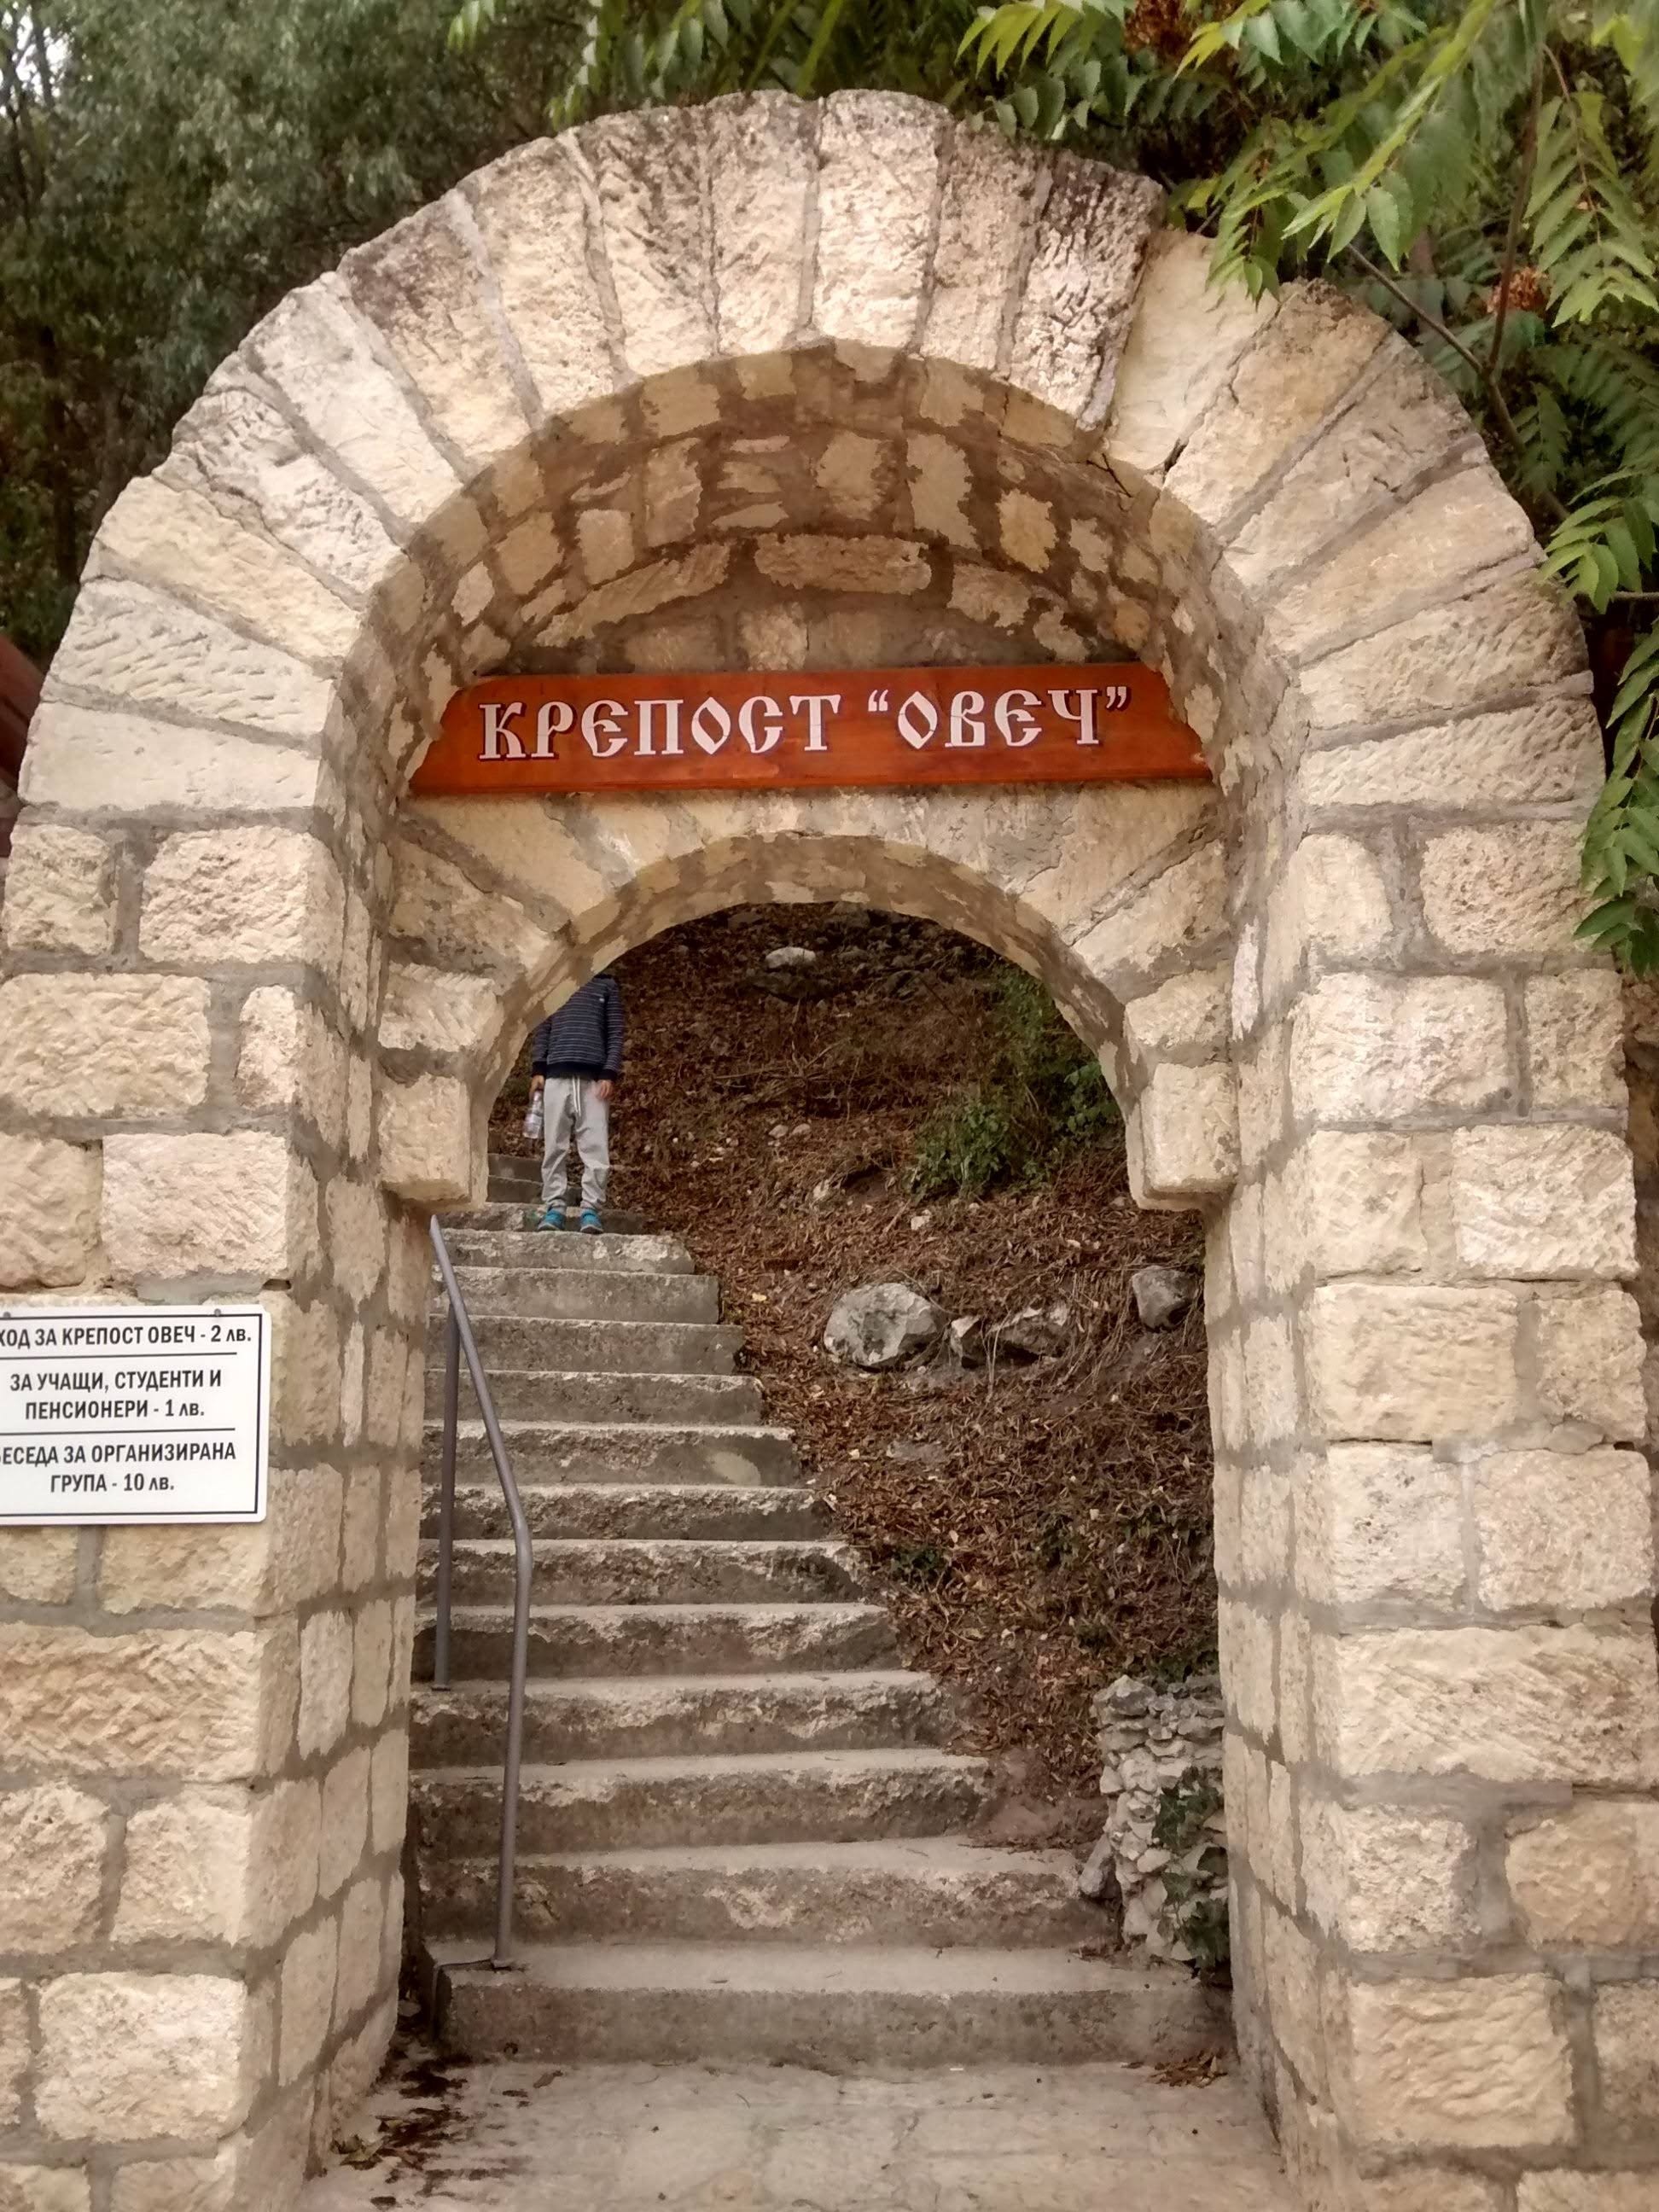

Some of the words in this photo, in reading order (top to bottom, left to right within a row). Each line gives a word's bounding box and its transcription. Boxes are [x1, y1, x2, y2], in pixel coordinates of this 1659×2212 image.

[478, 695, 841, 760] КРЕПОСТ
[35, 1328, 57, 1346] ЗА
[62, 1326, 143, 1346] КРЕПОСТ
[148, 1325, 195, 1344] ОВЕЧ
[211, 1324, 221, 1342] 2
[225, 1328, 252, 1342] лв.
[10, 1373, 32, 1392] ЗА
[37, 1371, 109, 1394] УЧАЩИ,
[114, 1370, 204, 1392] СТУДЕНТИ
[209, 1369, 221, 1387] И
[26, 1400, 148, 1420] ПЕНСИОНЕРИ
[166, 1399, 174, 1417] 1
[178, 1403, 204, 1417] лв.
[0, 1446, 59, 1468] ЕСЕДА
[63, 1445, 86, 1464] ЗА
[91, 1442, 236, 1463] ОРГАНИЗИРАНА
[50, 1474, 108, 1493] ГРУПА
[124, 1473, 144, 1492] 10
[148, 1476, 174, 1491] лв.
